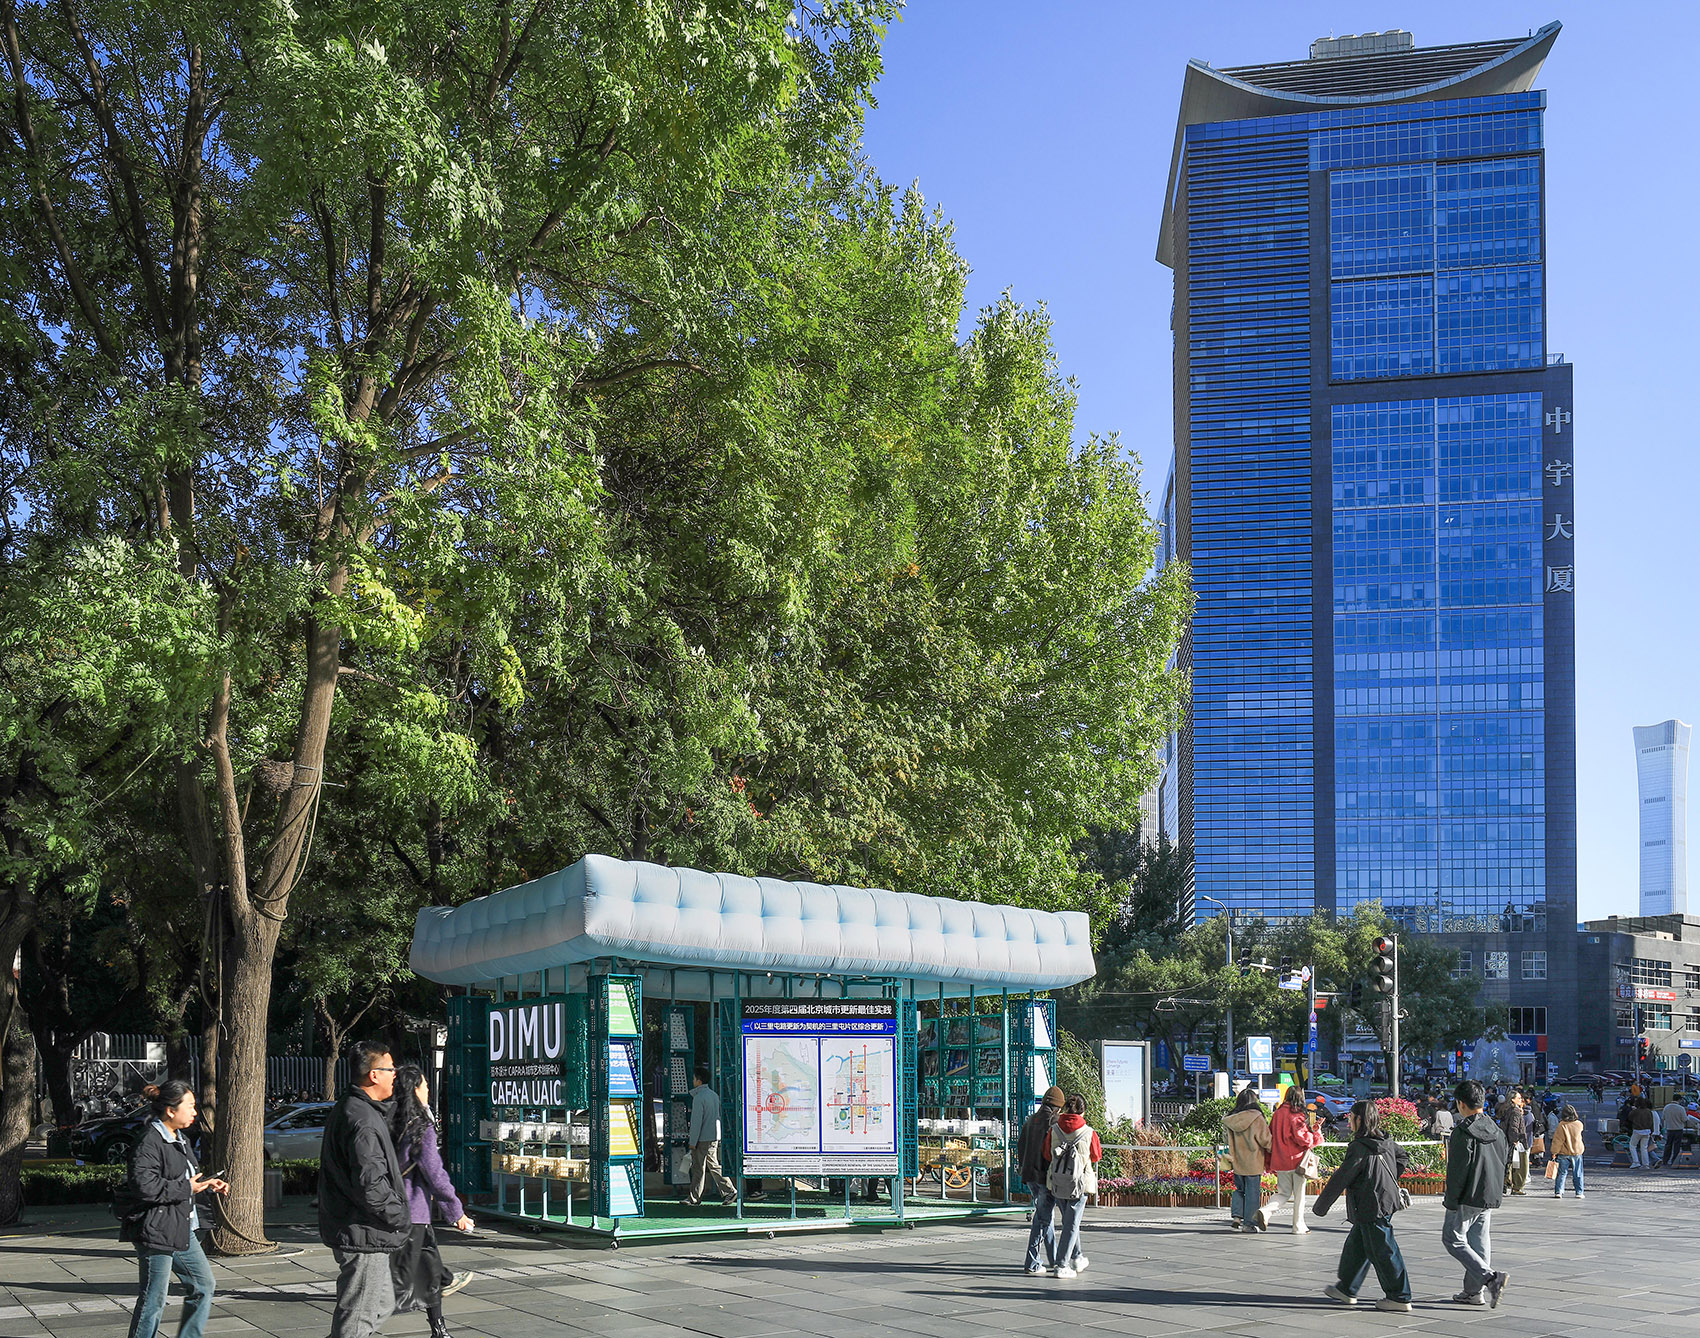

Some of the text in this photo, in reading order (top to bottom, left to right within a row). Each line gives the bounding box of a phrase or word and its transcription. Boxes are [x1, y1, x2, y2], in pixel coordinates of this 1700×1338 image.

[1546, 406, 1574, 593] 中宇大厦
[489, 1002, 563, 1061] DIMU
[1252, 1061, 1271, 1071] 机动车
[532, 1079, 563, 1106] UAIC
